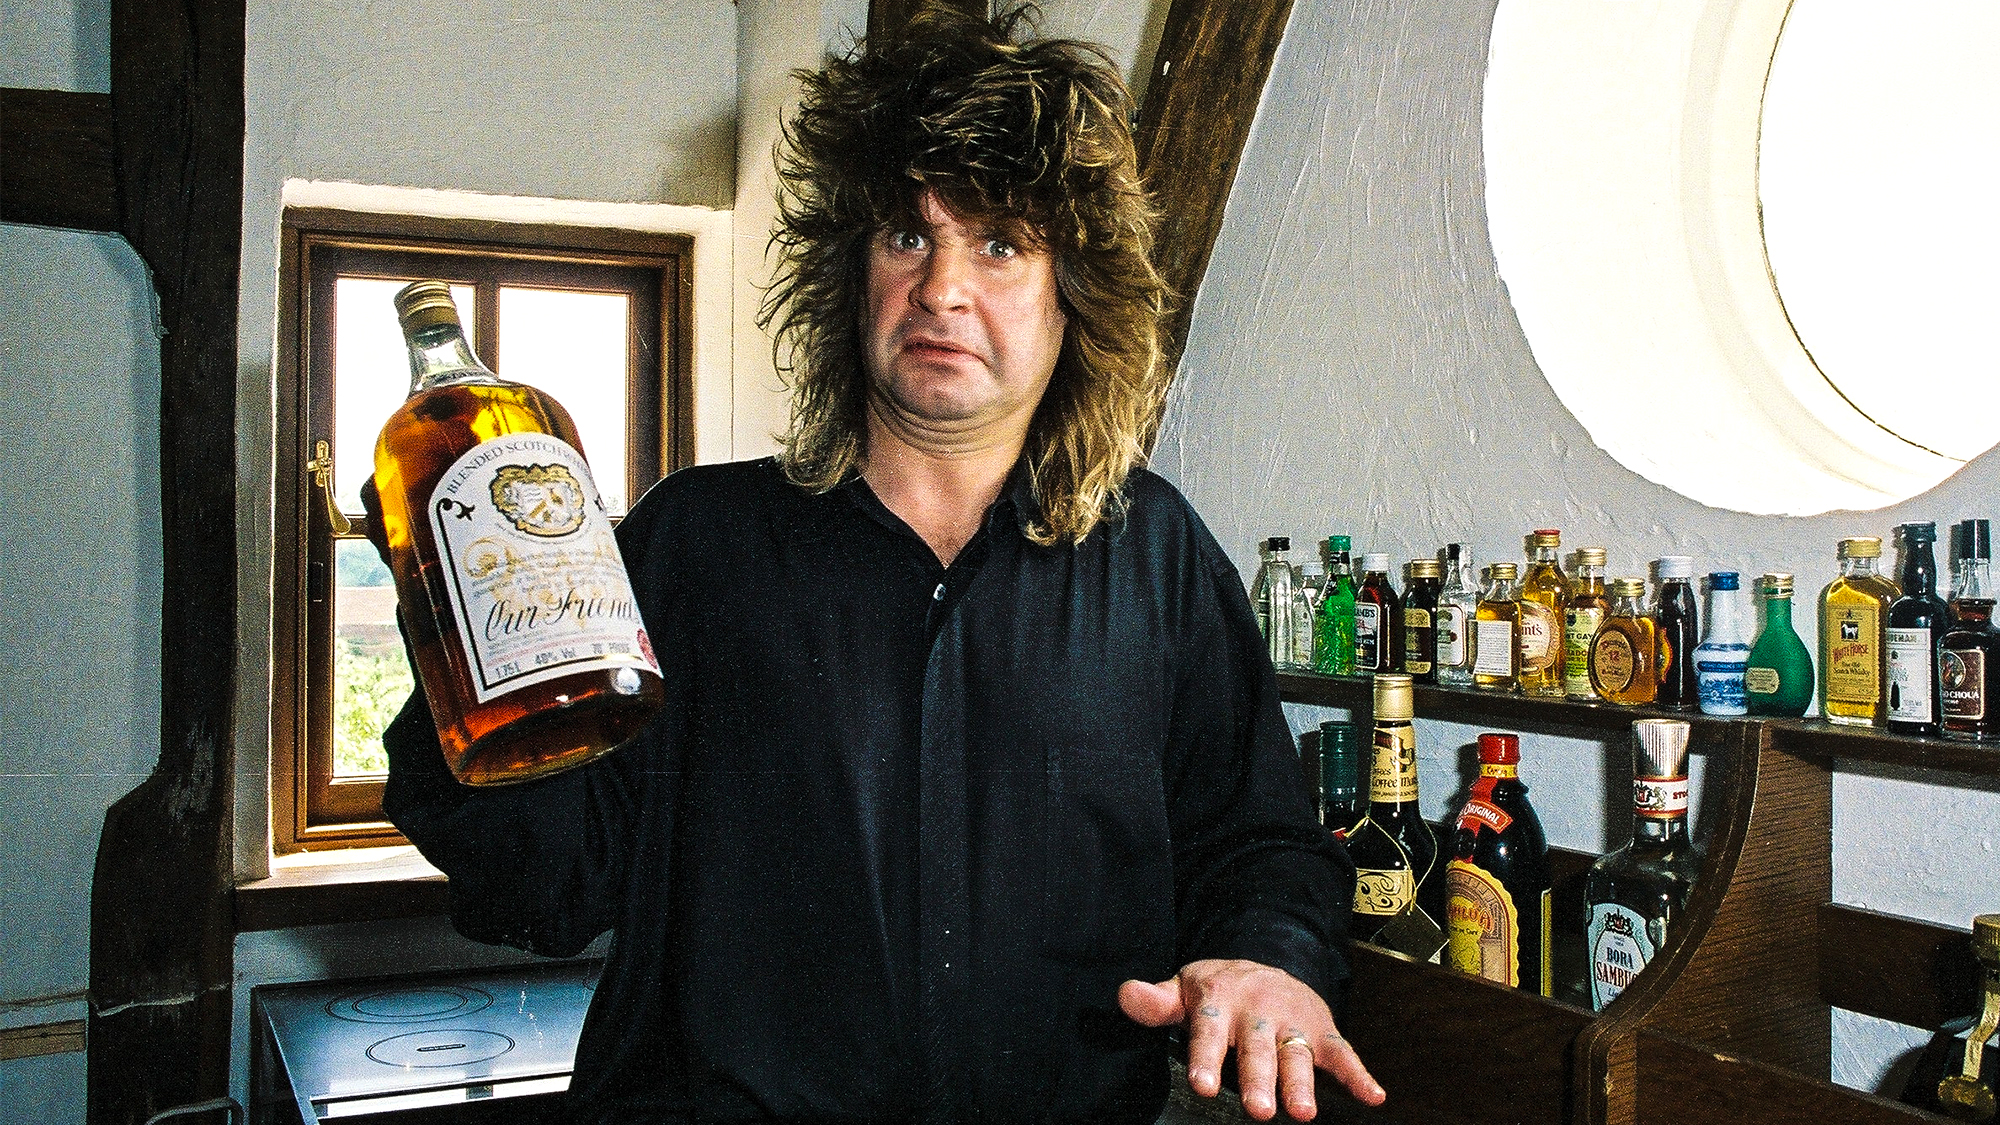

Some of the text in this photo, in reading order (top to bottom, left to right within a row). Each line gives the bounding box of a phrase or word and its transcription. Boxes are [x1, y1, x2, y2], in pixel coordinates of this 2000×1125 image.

[447, 446, 503, 494] BLENDED
[505, 440, 562, 456] SCOTCH
[1463, 802, 1501, 825] ORIGINAL
[1606, 946, 1634, 969] BORA
